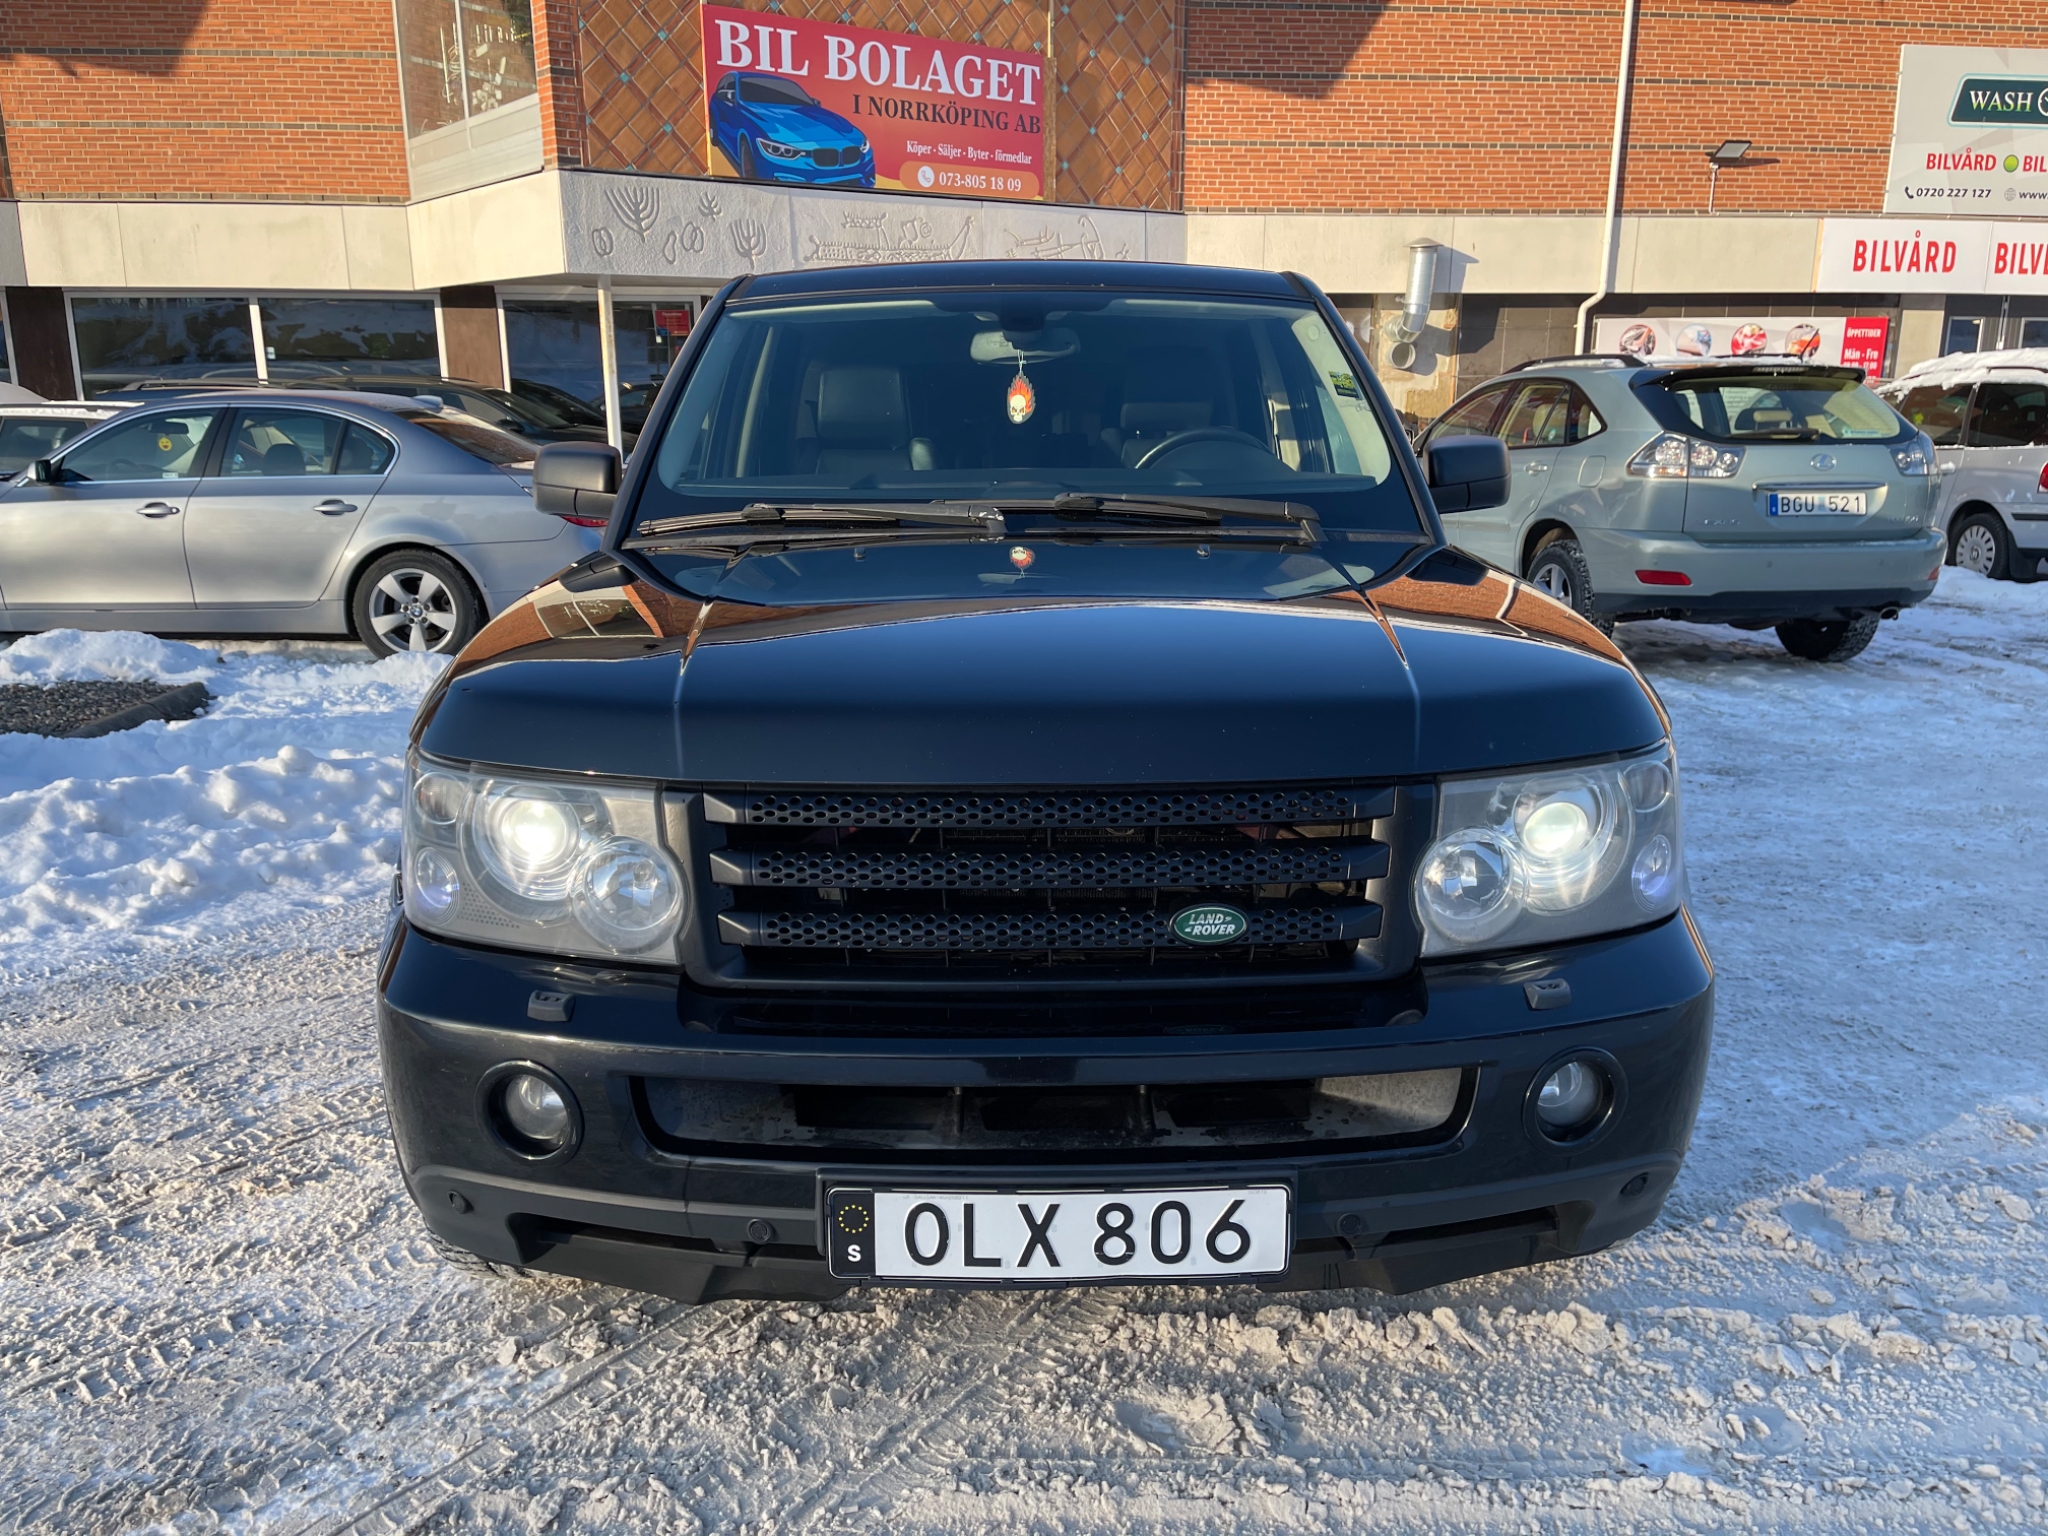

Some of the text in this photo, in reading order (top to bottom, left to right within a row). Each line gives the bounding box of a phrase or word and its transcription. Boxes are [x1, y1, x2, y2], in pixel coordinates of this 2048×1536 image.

[714, 19, 1041, 105] BIL BOLAGET
[1969, 90, 2034, 112] WASH
[852, 93, 1042, 134] I NORRKÖPING AB
[906, 140, 932, 156] Köper
[938, 143, 962, 159] Säljer
[967, 146, 990, 161] Byter
[995, 149, 1032, 165] förmedlar
[1926, 147, 2048, 173] BILVÅRD BIL
[939, 171, 1022, 192] 073-805 18 09
[1916, 187, 1945, 198] 0720
[1946, 188, 1969, 198] 227
[1972, 188, 1992, 198] 127
[1852, 230, 1957, 273] BILVÅRD
[1780, 495, 1860, 514] BGU 521
[1188, 913, 1224, 925] LAND
[1192, 924, 1236, 936] ROVER
[904, 1199, 1252, 1268] OLX 806
[847, 1244, 862, 1263] S
